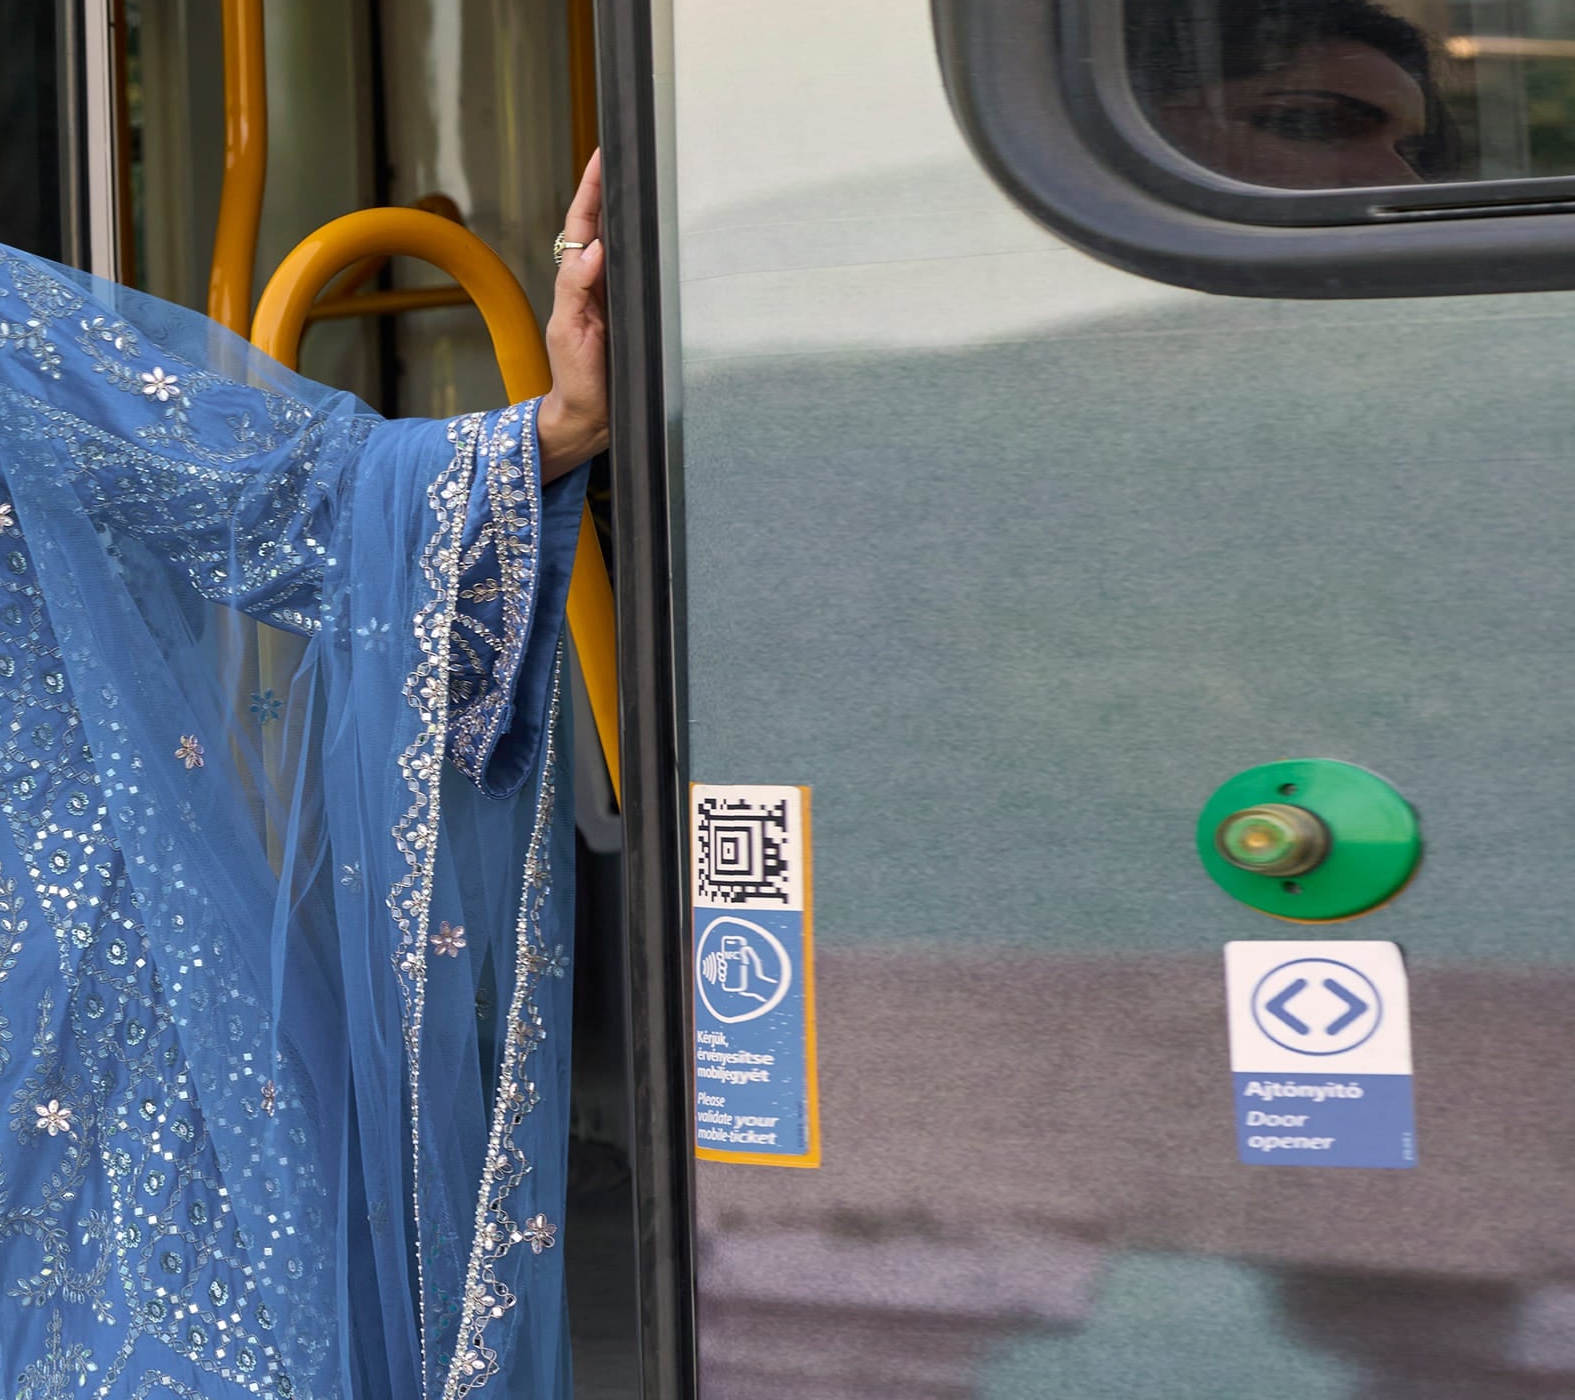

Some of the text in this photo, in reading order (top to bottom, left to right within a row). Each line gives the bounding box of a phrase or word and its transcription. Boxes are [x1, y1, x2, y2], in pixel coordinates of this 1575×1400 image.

[697, 1031, 729, 1047] Kérjük,
[697, 1047, 774, 1065] érvényesítse
[697, 1066, 770, 1085] mobiljegyét
[697, 1092, 725, 1107] Please
[1244, 1081, 1364, 1102] Ajtónyitó
[697, 1110, 779, 1129] validate your
[1245, 1110, 1310, 1127] Door
[1247, 1135, 1336, 1152] opener
